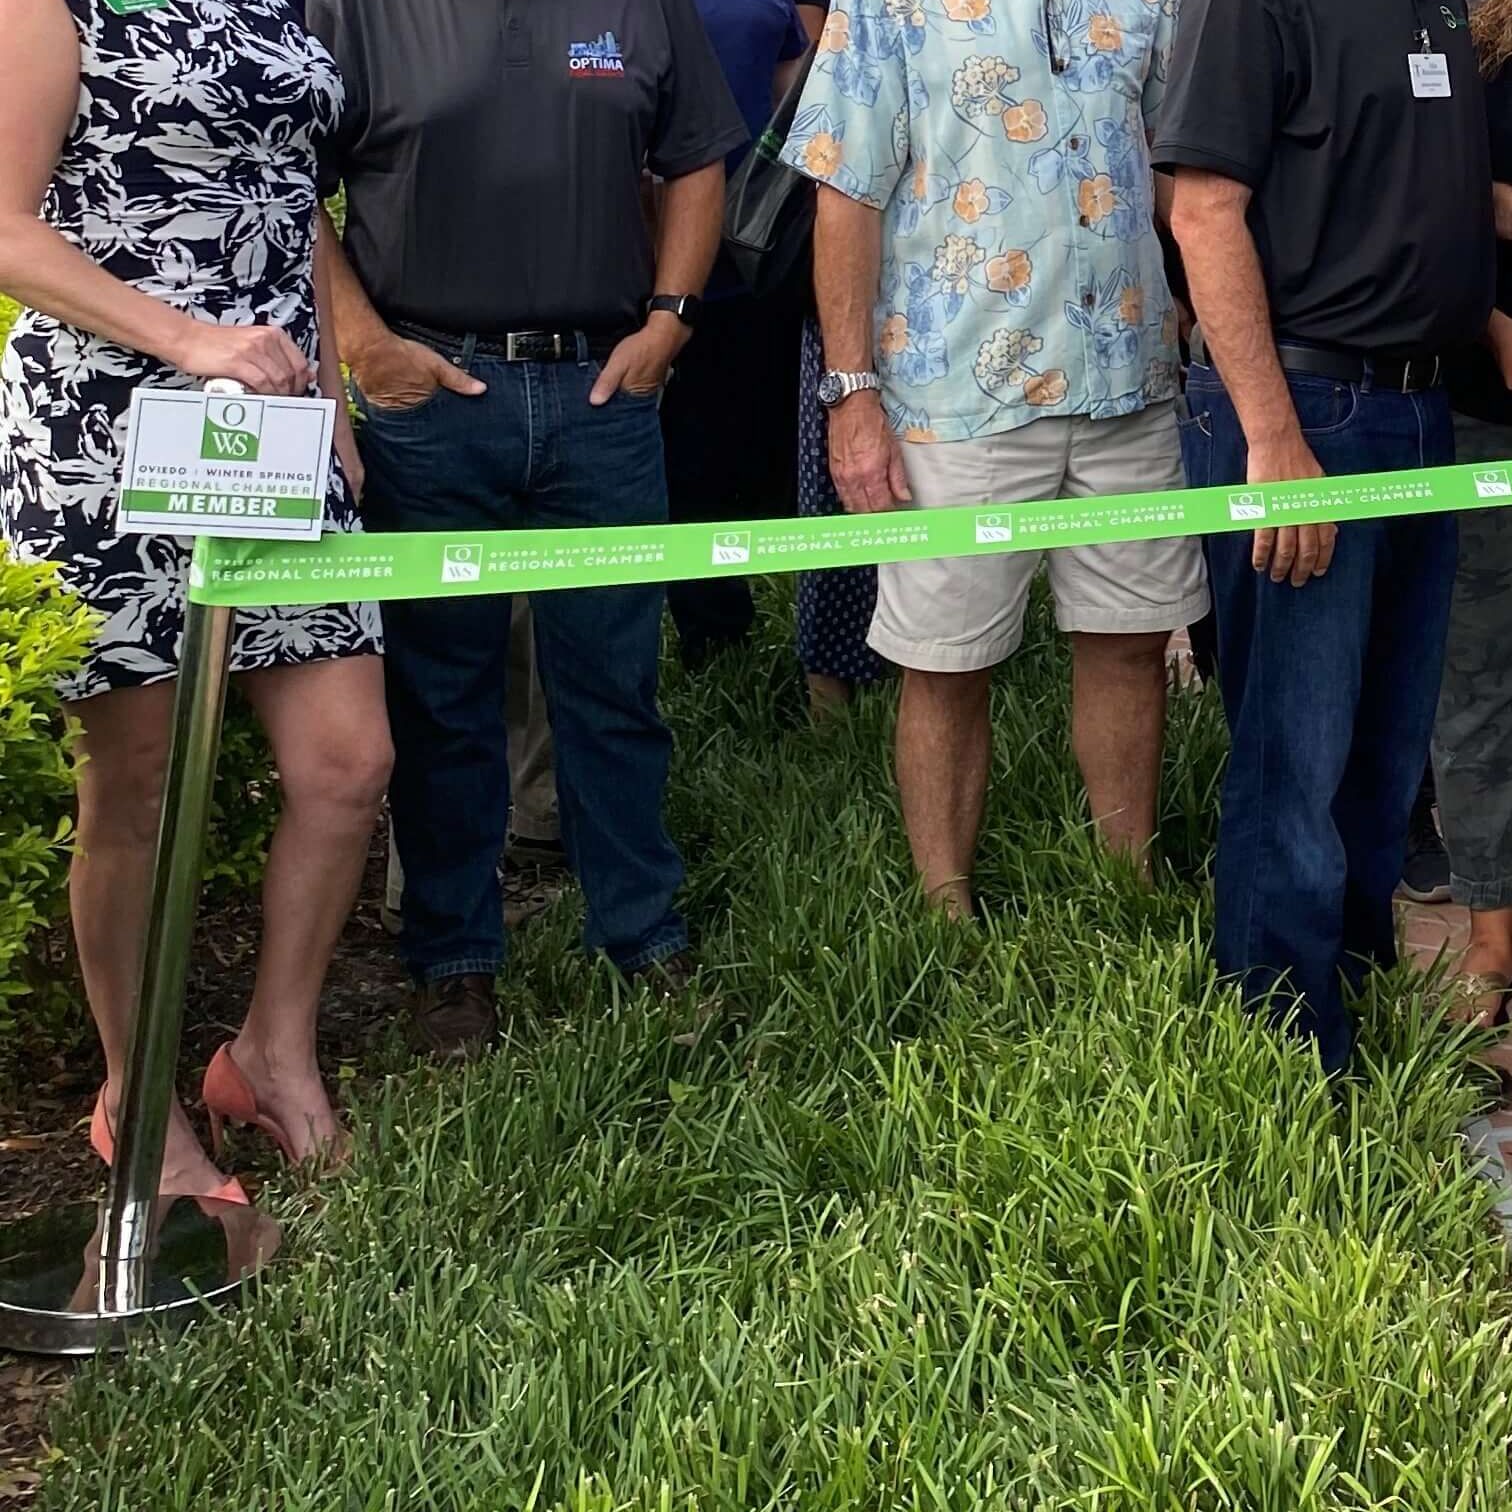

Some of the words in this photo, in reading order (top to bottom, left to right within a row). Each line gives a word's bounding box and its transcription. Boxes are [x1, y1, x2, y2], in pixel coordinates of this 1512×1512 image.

[569, 57, 624, 71] OPTIMA
[222, 402, 246, 426] O
[212, 431, 248, 456] WS
[138, 465, 187, 476] OVIEDO
[206, 468, 253, 479] WINTER
[260, 471, 313, 482] SPRINGS
[136, 478, 222, 492] REGIONAL
[231, 482, 311, 496] CHAMBER
[168, 494, 278, 516] MEMBER
[1272, 497, 1352, 511] REGIONAL
[1360, 489, 1433, 503] CHAMBER
[1018, 519, 1102, 534] REGIONAL
[1109, 511, 1185, 526] CHAMBER
[757, 541, 843, 555] REGIONAL
[850, 533, 929, 548] CHAMBER
[488, 558, 576, 572] REGIONAL
[583, 552, 664, 567] CHAMBER
[212, 569, 301, 582] REGIONAL
[311, 566, 393, 579] CHAMBER
